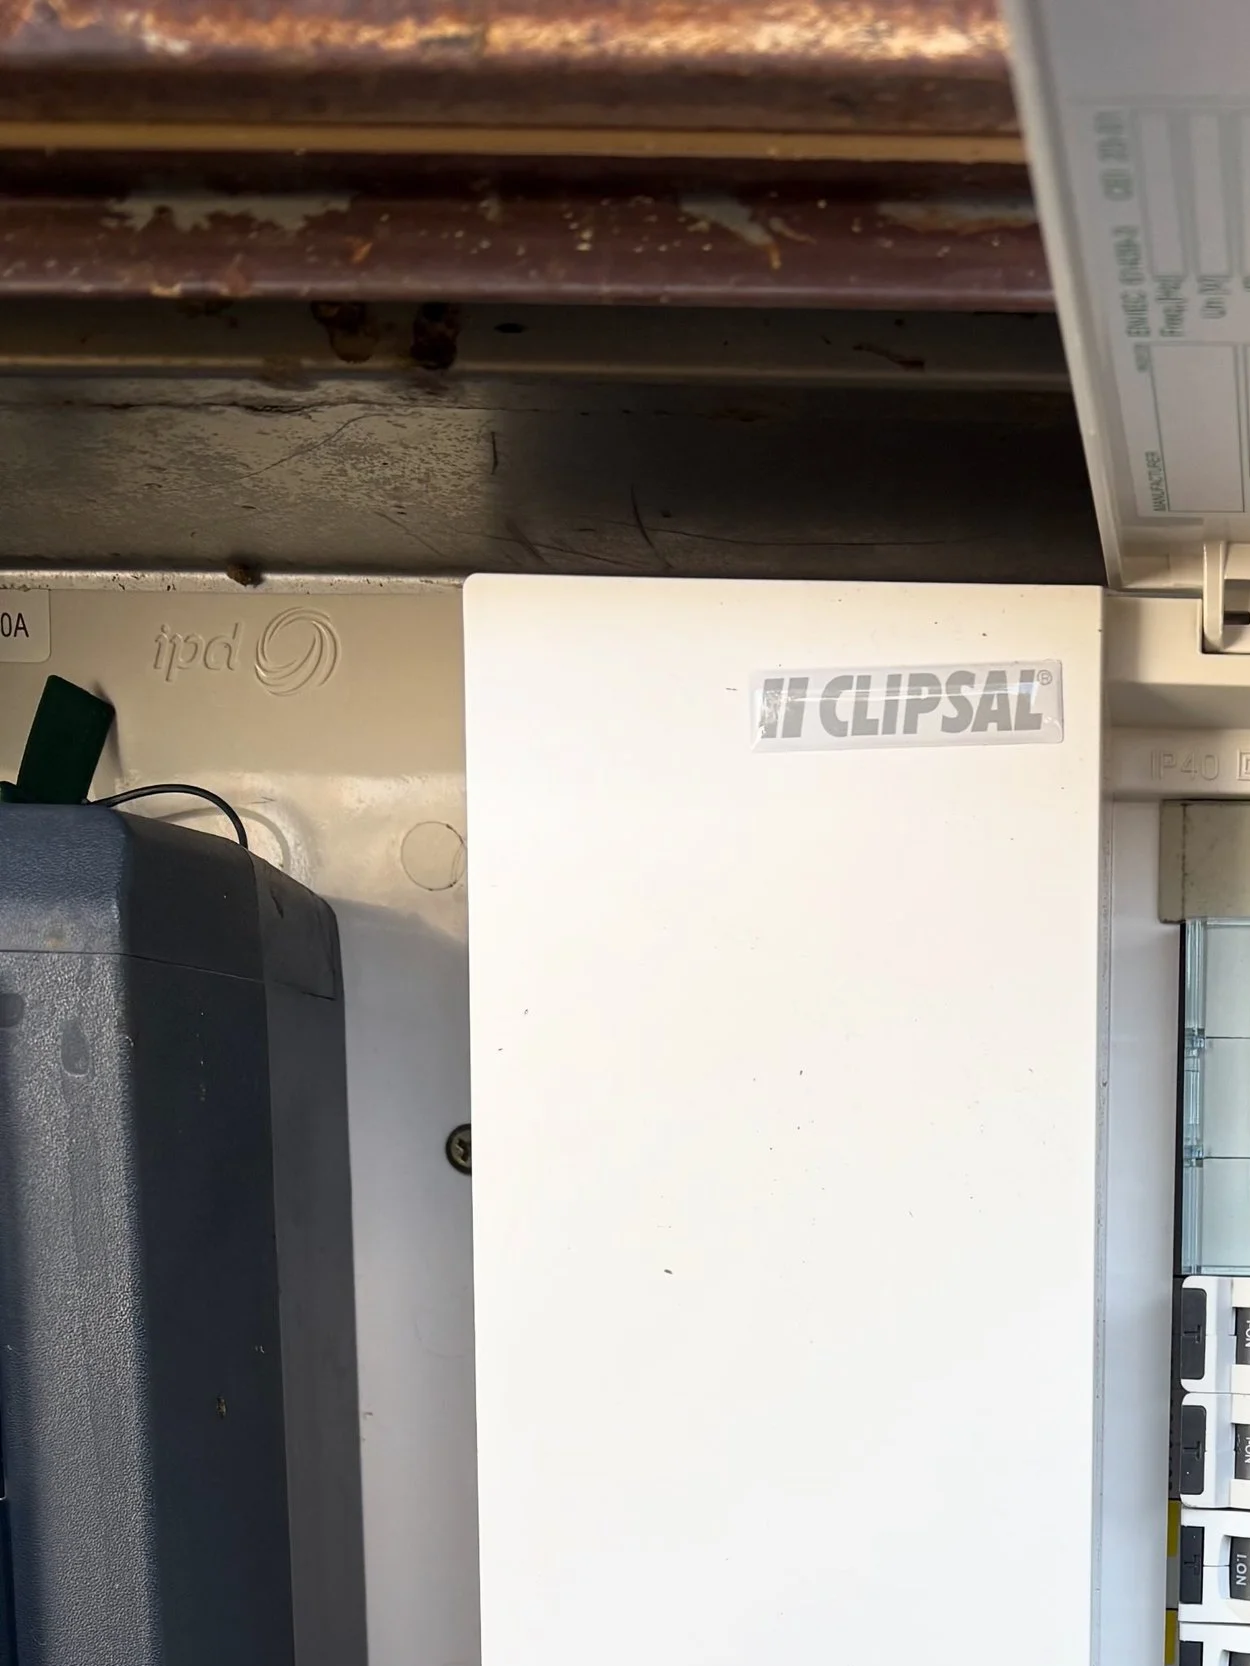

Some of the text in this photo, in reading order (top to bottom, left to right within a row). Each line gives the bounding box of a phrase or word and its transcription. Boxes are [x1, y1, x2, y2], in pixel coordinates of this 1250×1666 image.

[1145, 451, 1167, 512] MANUFACTURER
[153, 621, 243, 683] ipd
[820, 668, 1043, 741] CLIPSAL
